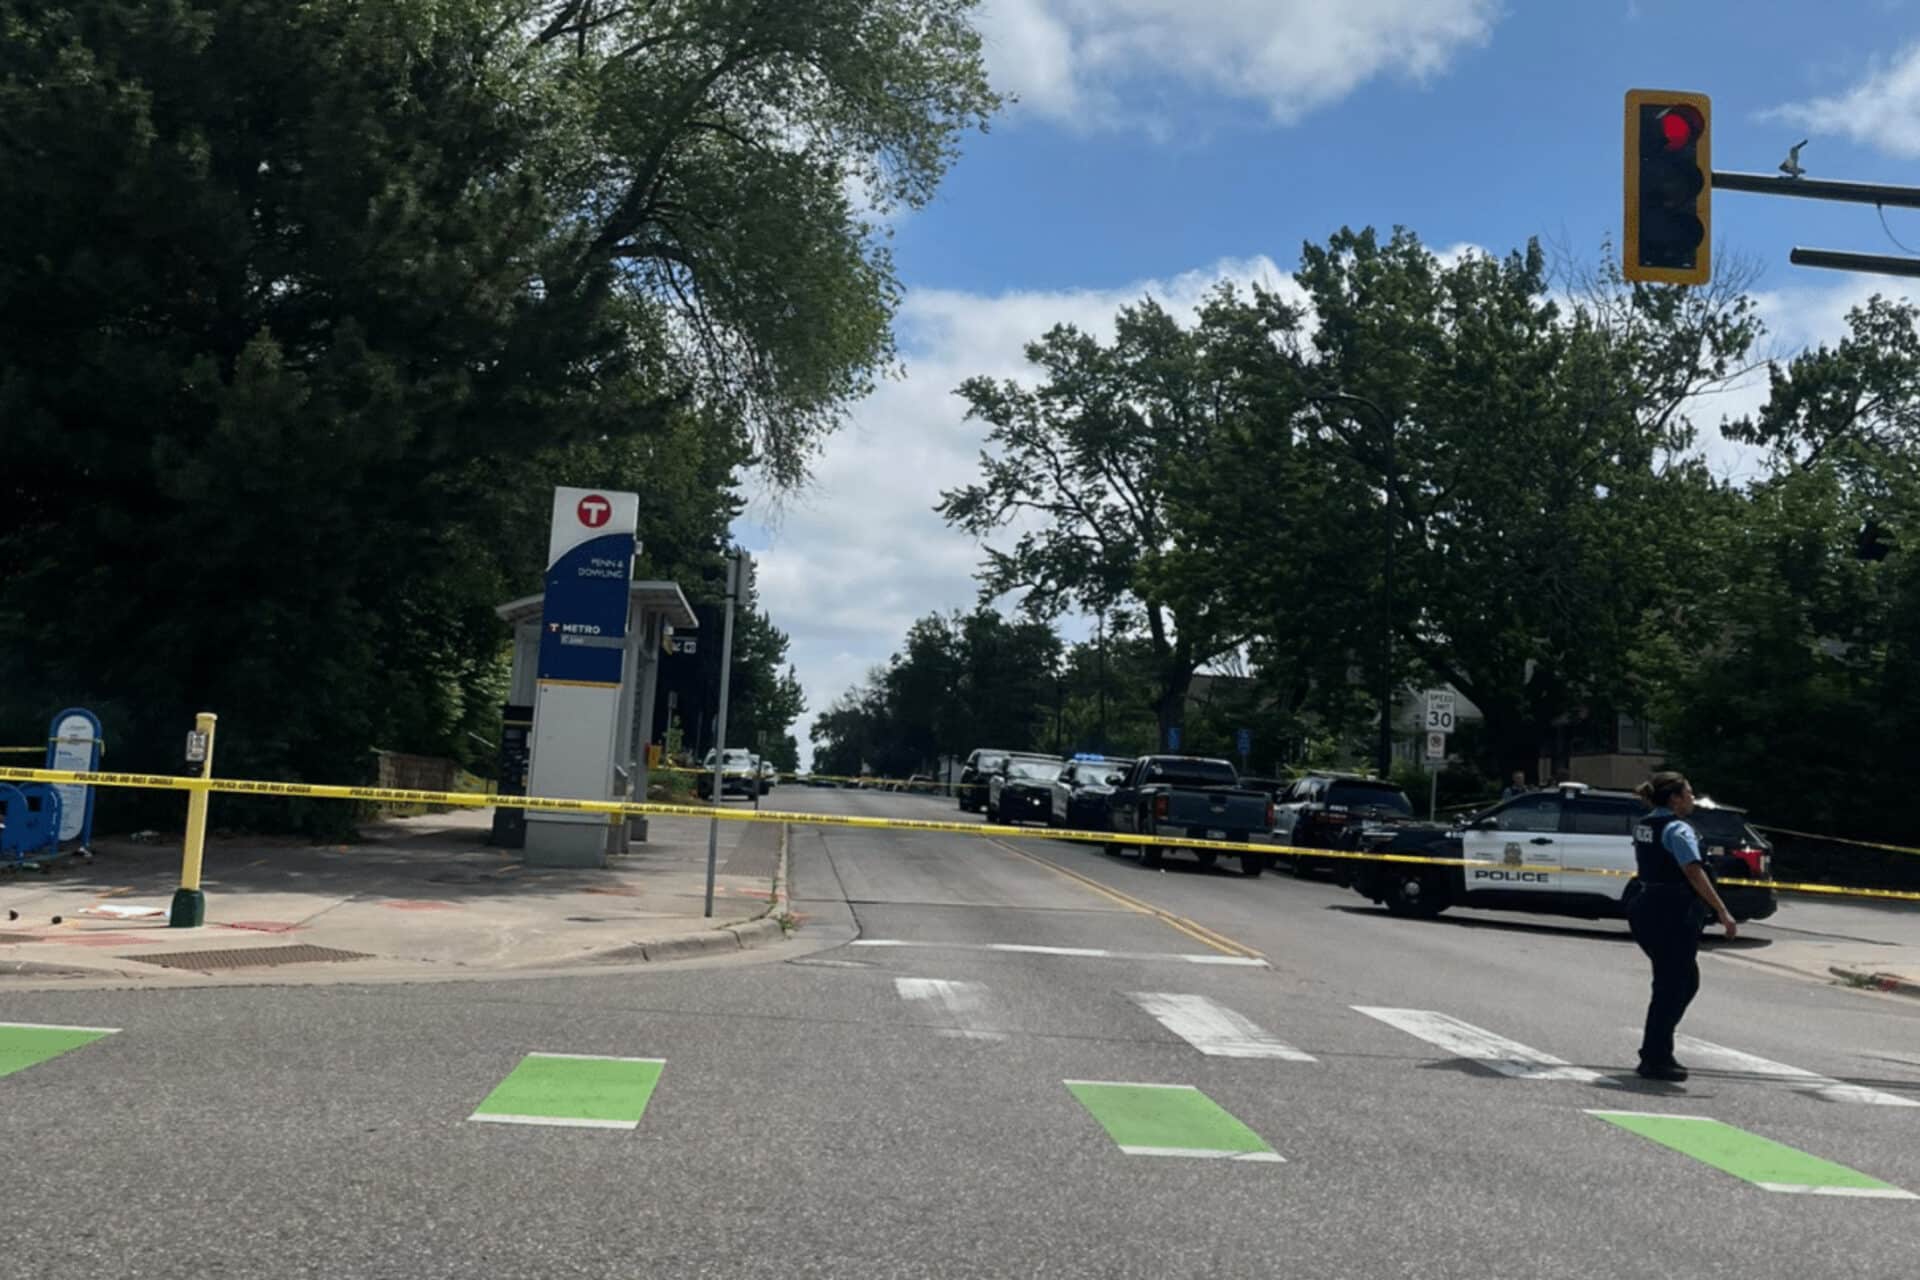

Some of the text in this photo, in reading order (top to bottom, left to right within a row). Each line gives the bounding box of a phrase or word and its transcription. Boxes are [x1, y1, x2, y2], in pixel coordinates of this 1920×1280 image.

[582, 502, 608, 524] T
[591, 558, 616, 569] PENN
[578, 567, 624, 578] DOWLING
[562, 623, 601, 635] METRO
[1430, 693, 1454, 703] SPEED
[1428, 711, 1452, 728] 30
[74, 773, 99, 782] POLICE
[212, 780, 237, 789] POLICE
[1474, 870, 1549, 883] POLICE
